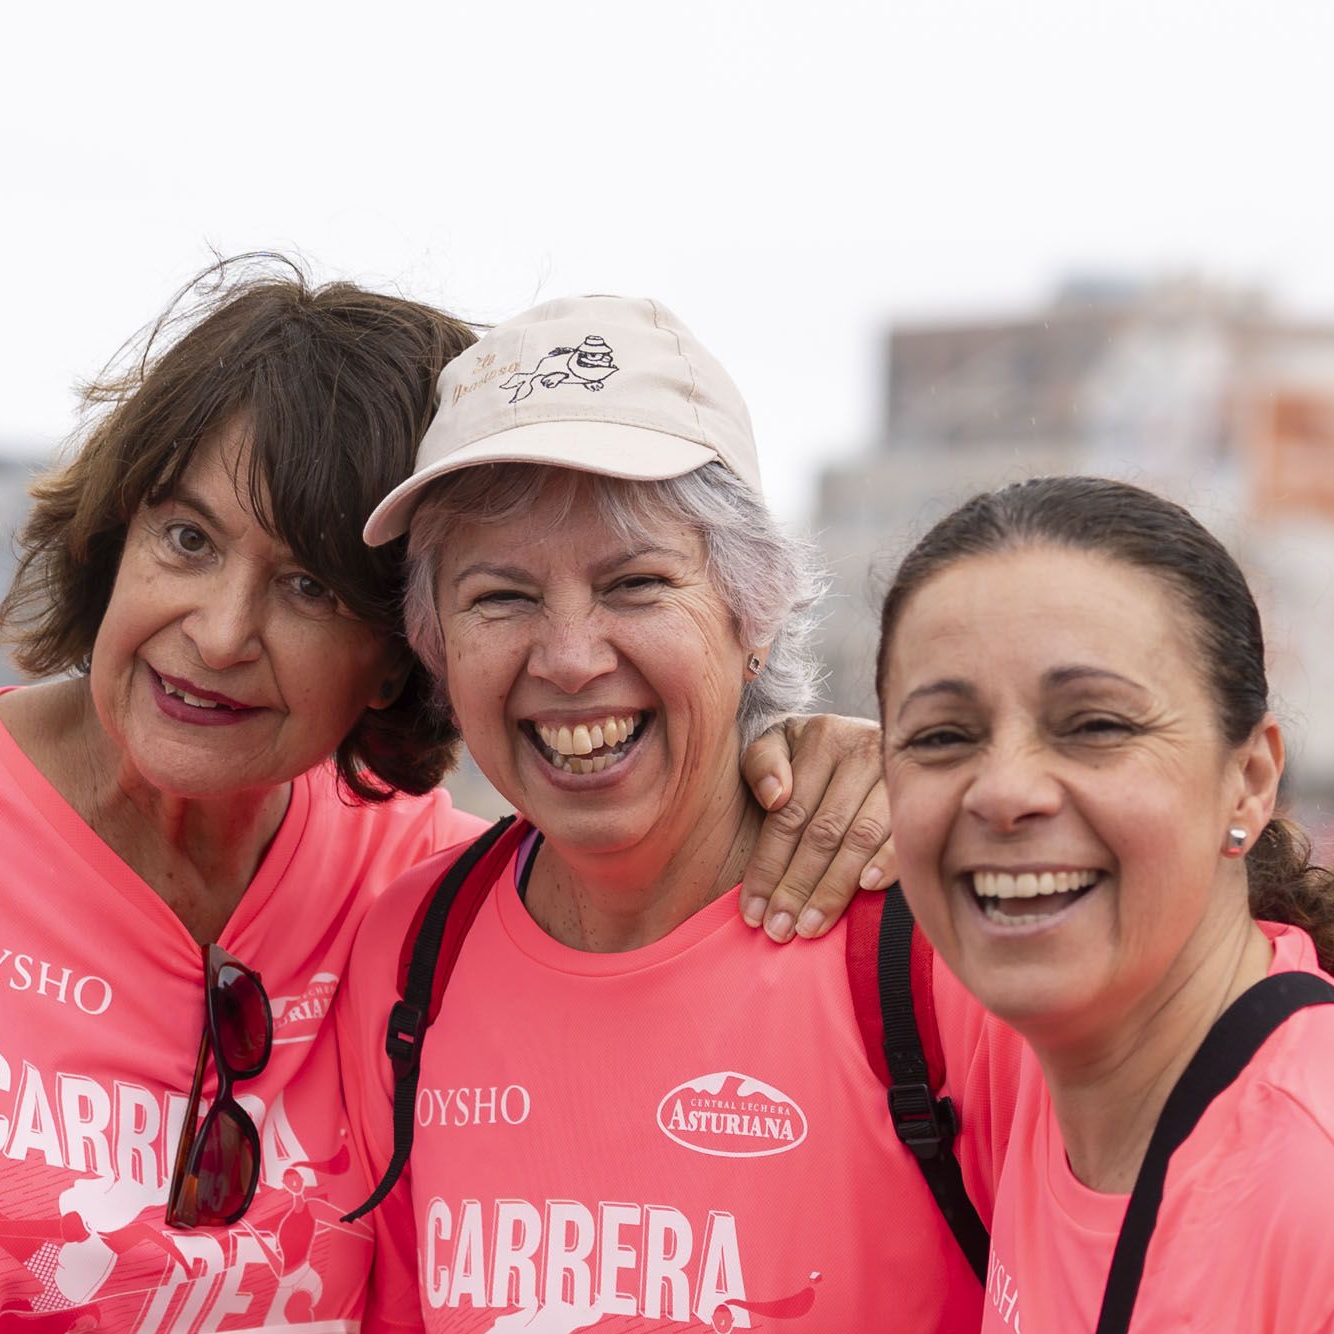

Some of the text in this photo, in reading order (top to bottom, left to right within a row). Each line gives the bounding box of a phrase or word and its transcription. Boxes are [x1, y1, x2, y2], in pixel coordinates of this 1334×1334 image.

[417, 1085, 531, 1127] OYSHO
[666, 1098, 795, 1141] ASTURIANA
[690, 1098, 791, 1116] CENTRAL LECHERA
[425, 1196, 752, 1329] CARRERA
